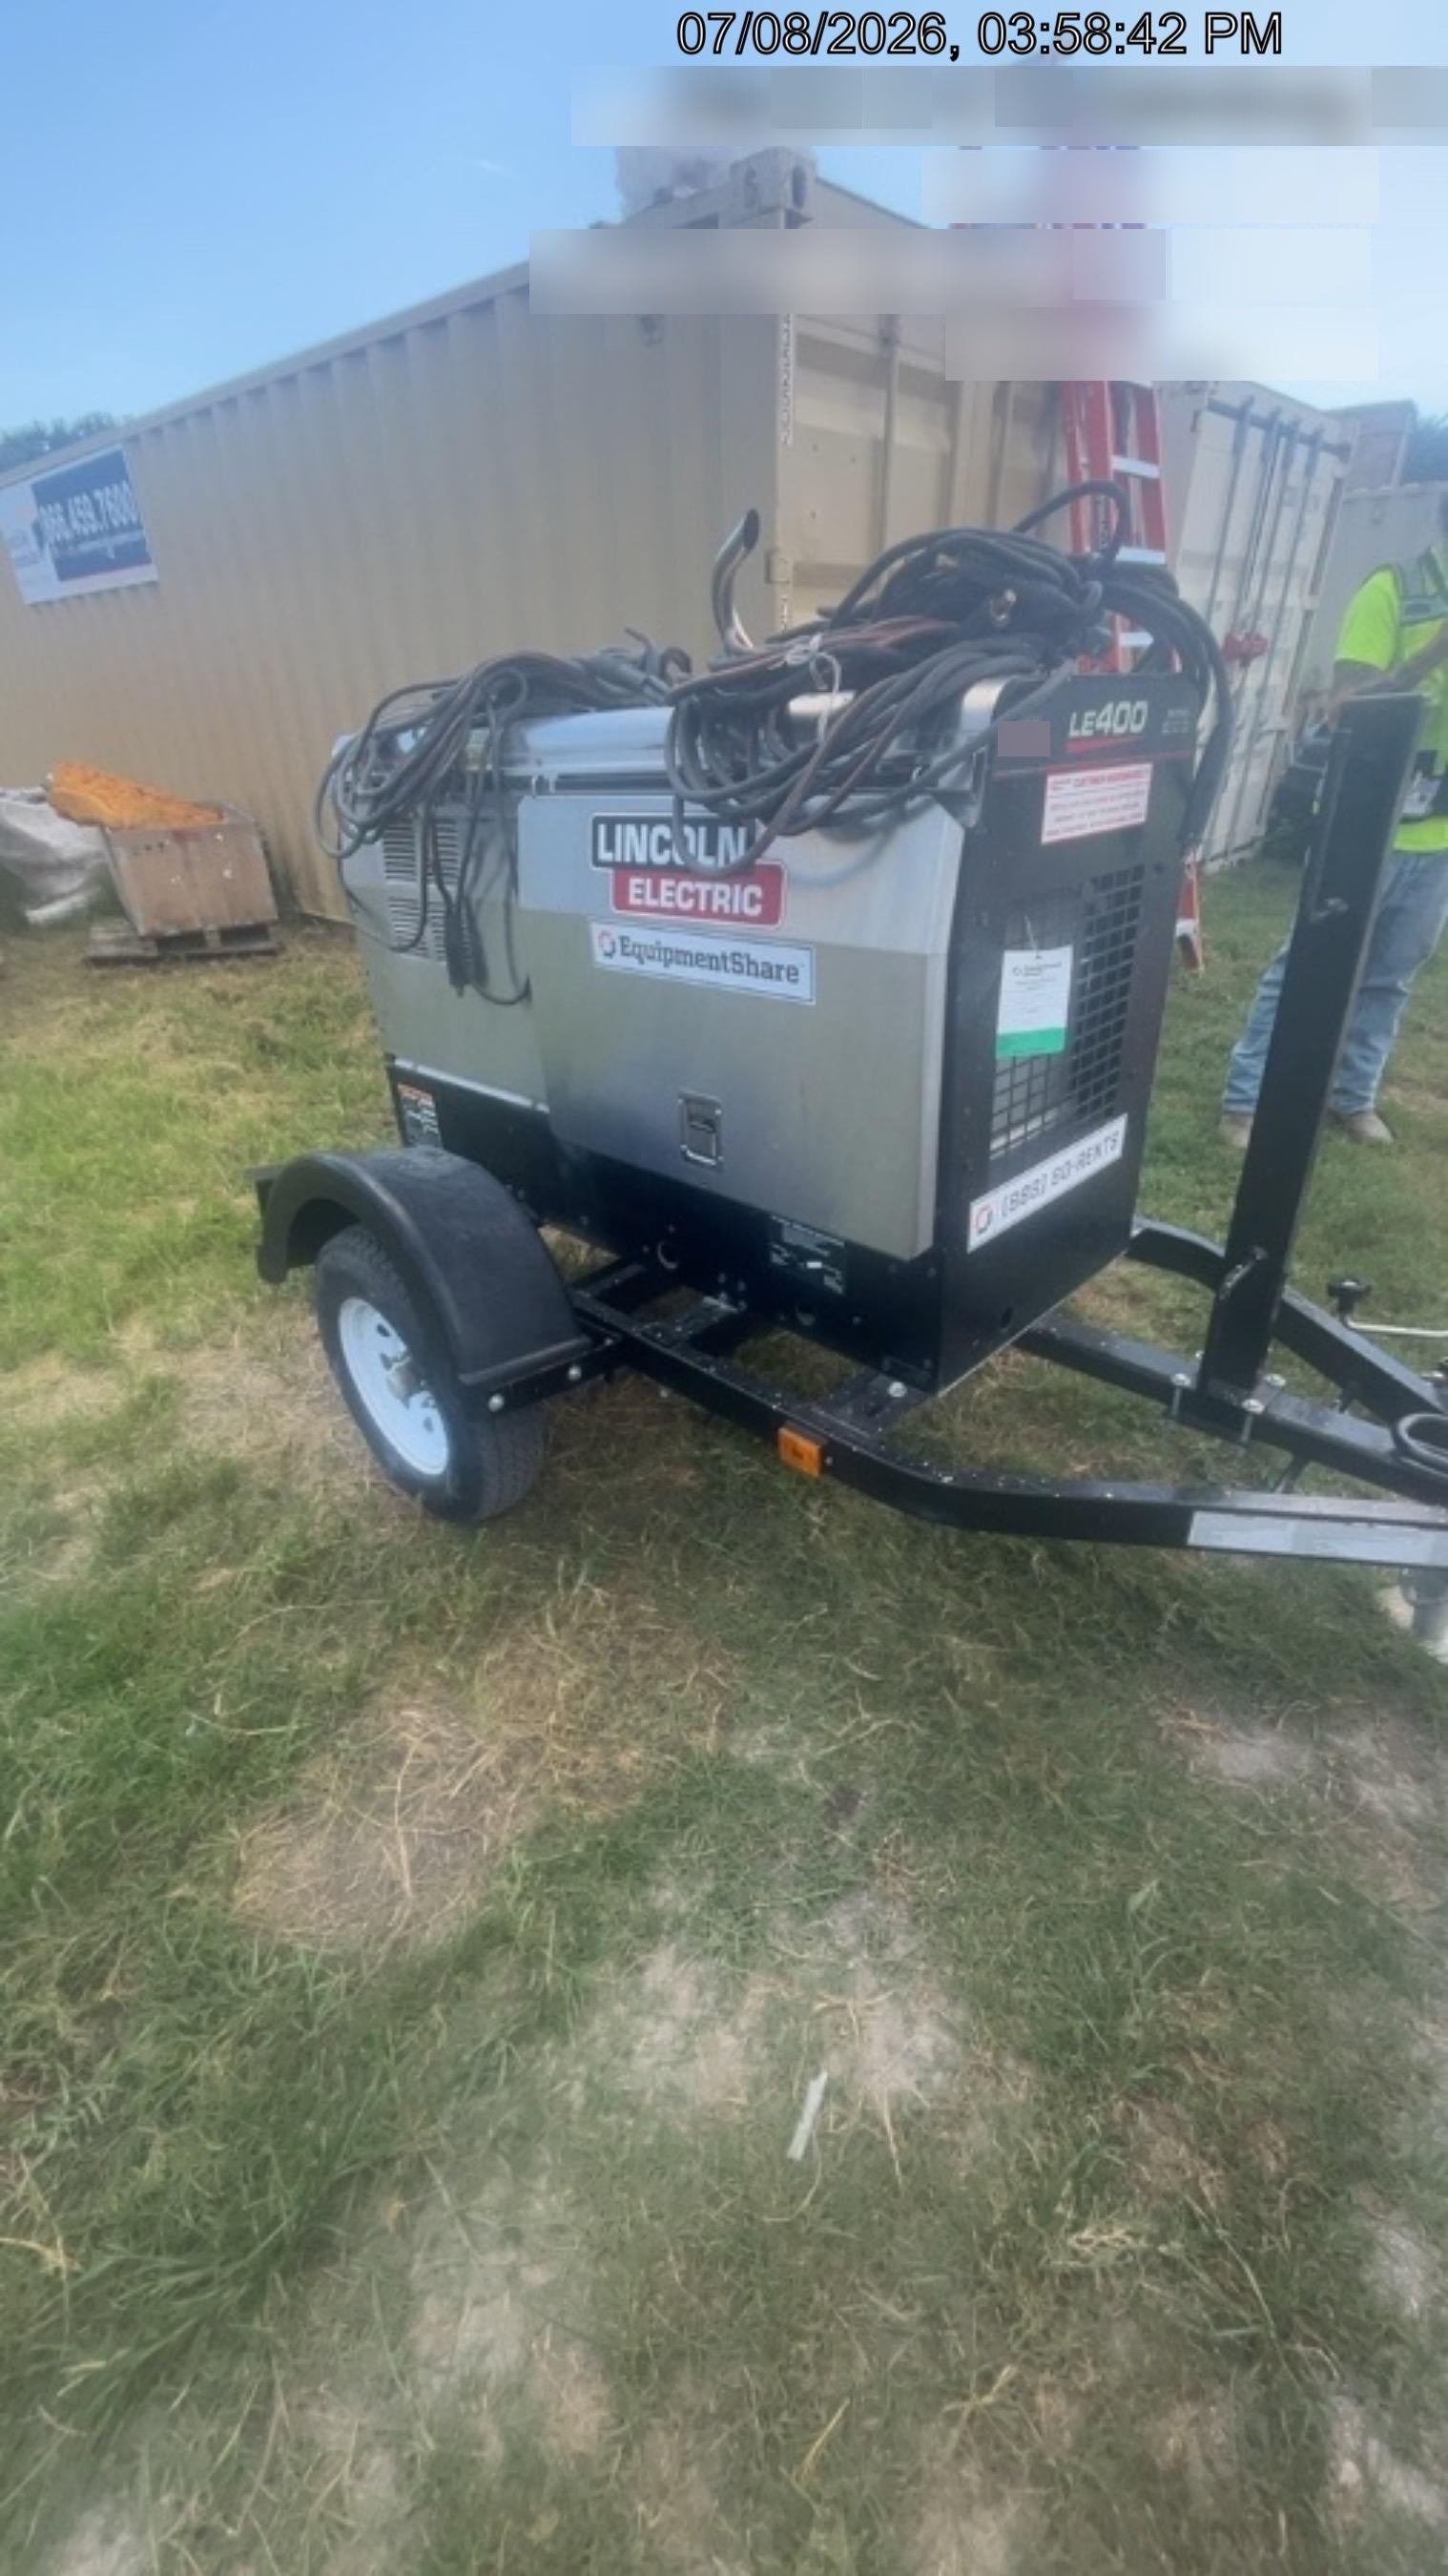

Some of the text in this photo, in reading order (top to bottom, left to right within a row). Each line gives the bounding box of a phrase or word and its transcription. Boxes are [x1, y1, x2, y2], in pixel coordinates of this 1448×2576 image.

[1068, 700, 1148, 737] LE400
[629, 877, 763, 917] ELECTRIC
[618, 935, 800, 984] EquipmentShare
